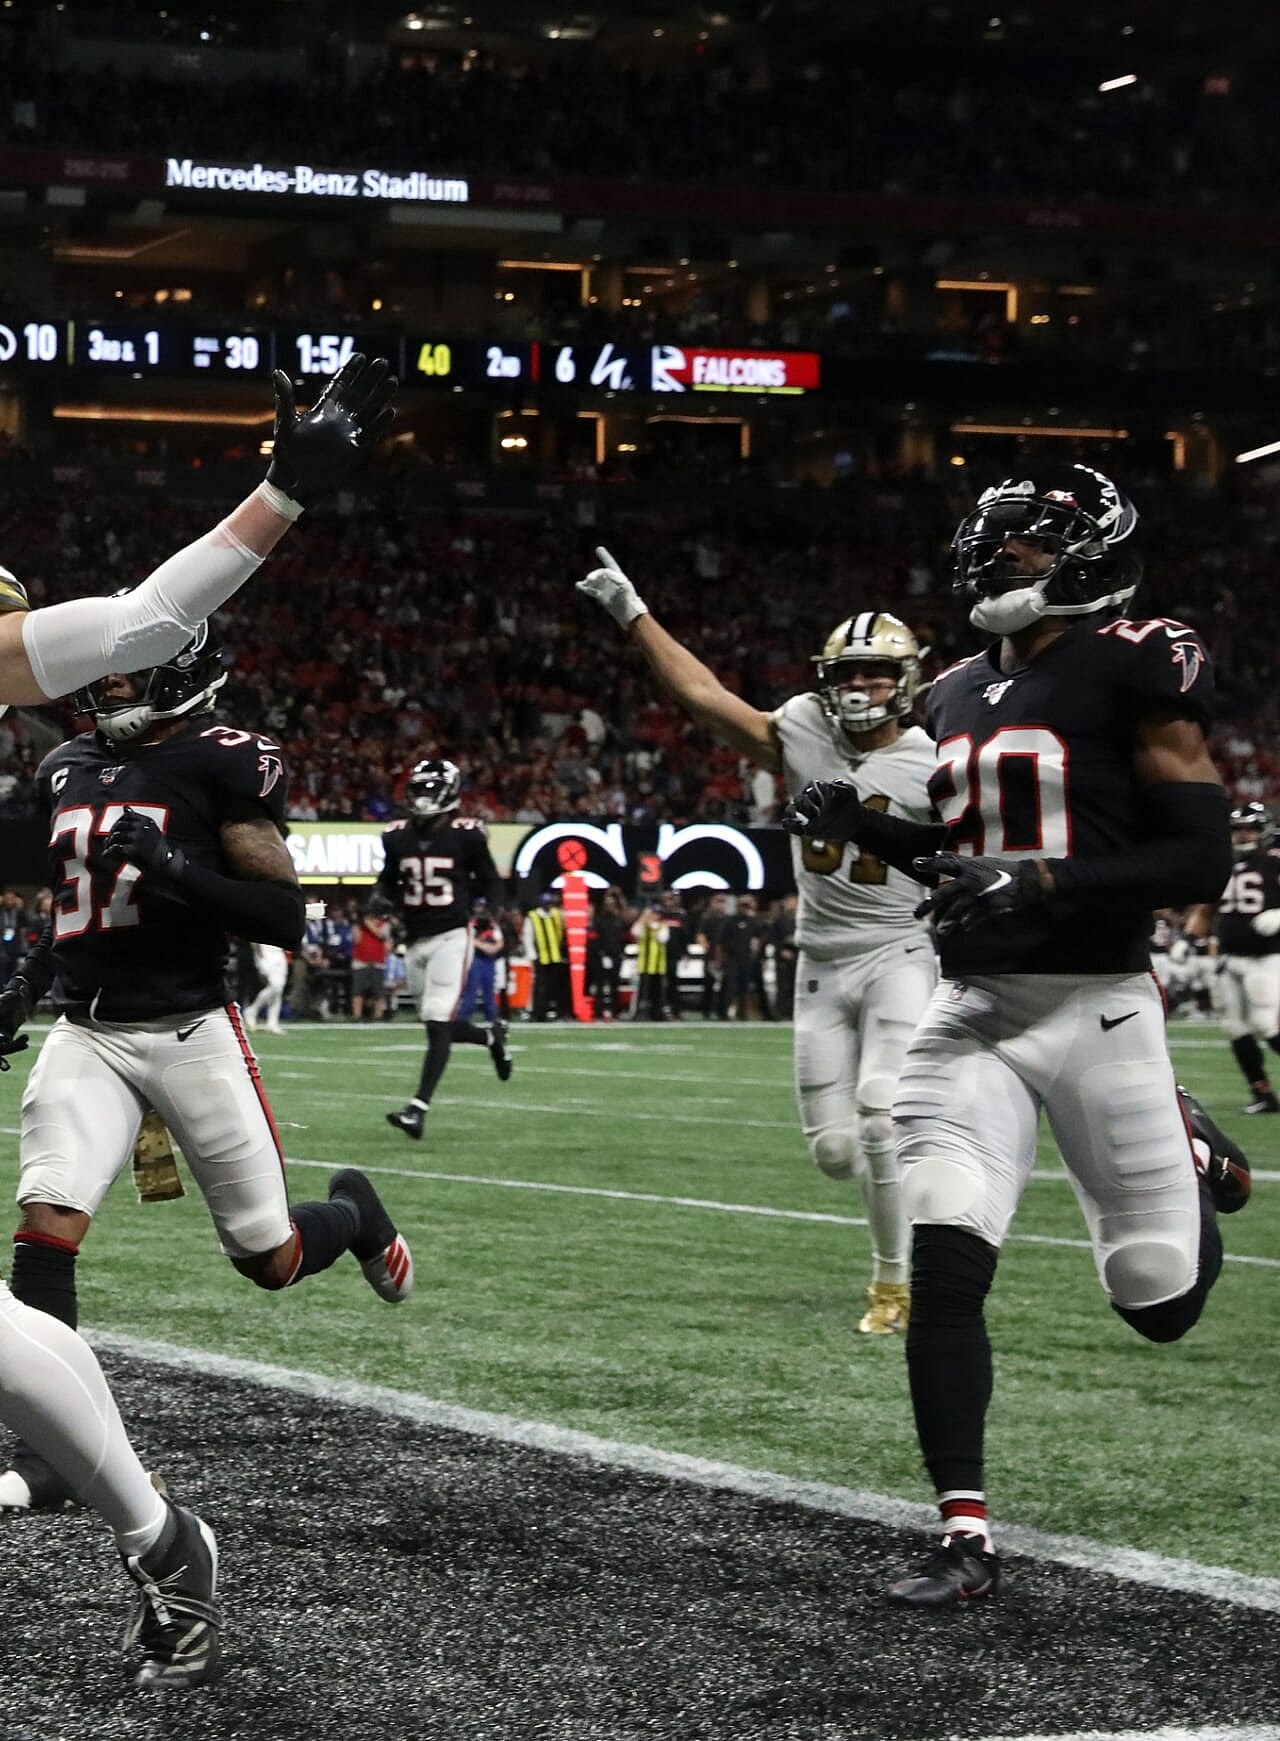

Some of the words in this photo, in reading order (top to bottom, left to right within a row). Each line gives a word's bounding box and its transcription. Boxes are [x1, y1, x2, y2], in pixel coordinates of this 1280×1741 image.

[166, 158, 358, 197] Mercedes-Benz
[363, 169, 469, 202] Stadium
[23, 323, 57, 361] 10
[144, 331, 159, 365] 1
[225, 336, 259, 370] 30
[417, 343, 451, 376] 40
[555, 346, 575, 383] 6
[692, 355, 787, 387] FALCONS
[51, 767, 69, 795] C
[48, 801, 171, 940] 37
[285, 834, 386, 873] SAINTS
[640, 855, 661, 883] 3
[399, 855, 455, 908] 35
